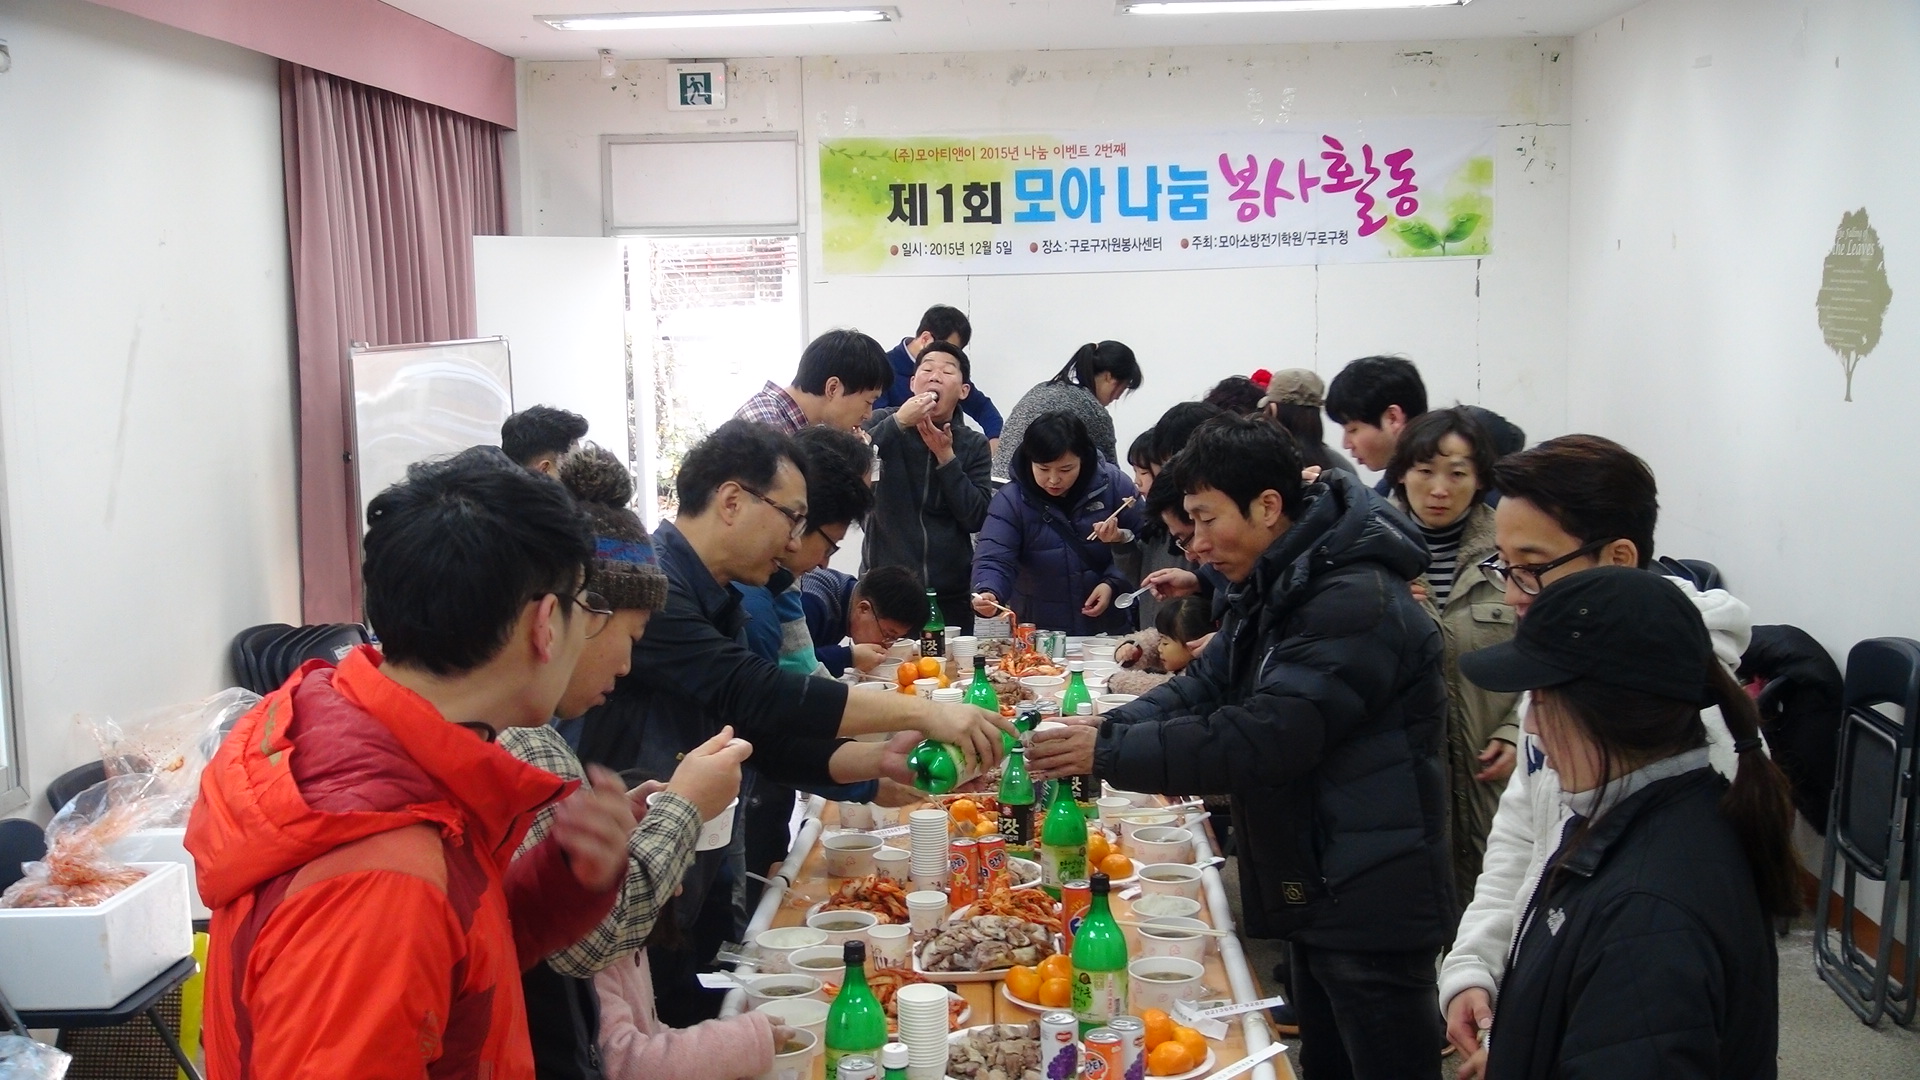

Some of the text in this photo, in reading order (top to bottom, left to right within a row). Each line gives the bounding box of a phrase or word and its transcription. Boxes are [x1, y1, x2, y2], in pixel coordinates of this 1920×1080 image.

[894, 143, 1127, 163] (주)모아티앤이 2015년 나눔 이벤트 2번째
[1014, 167, 1105, 223] 모아
[1117, 164, 1209, 223] 나눔
[1218, 134, 1419, 237] 봉사활동
[969, 241, 993, 256] 12월
[995, 240, 1013, 255] 5일
[1846, 239, 1875, 256] Leaves
